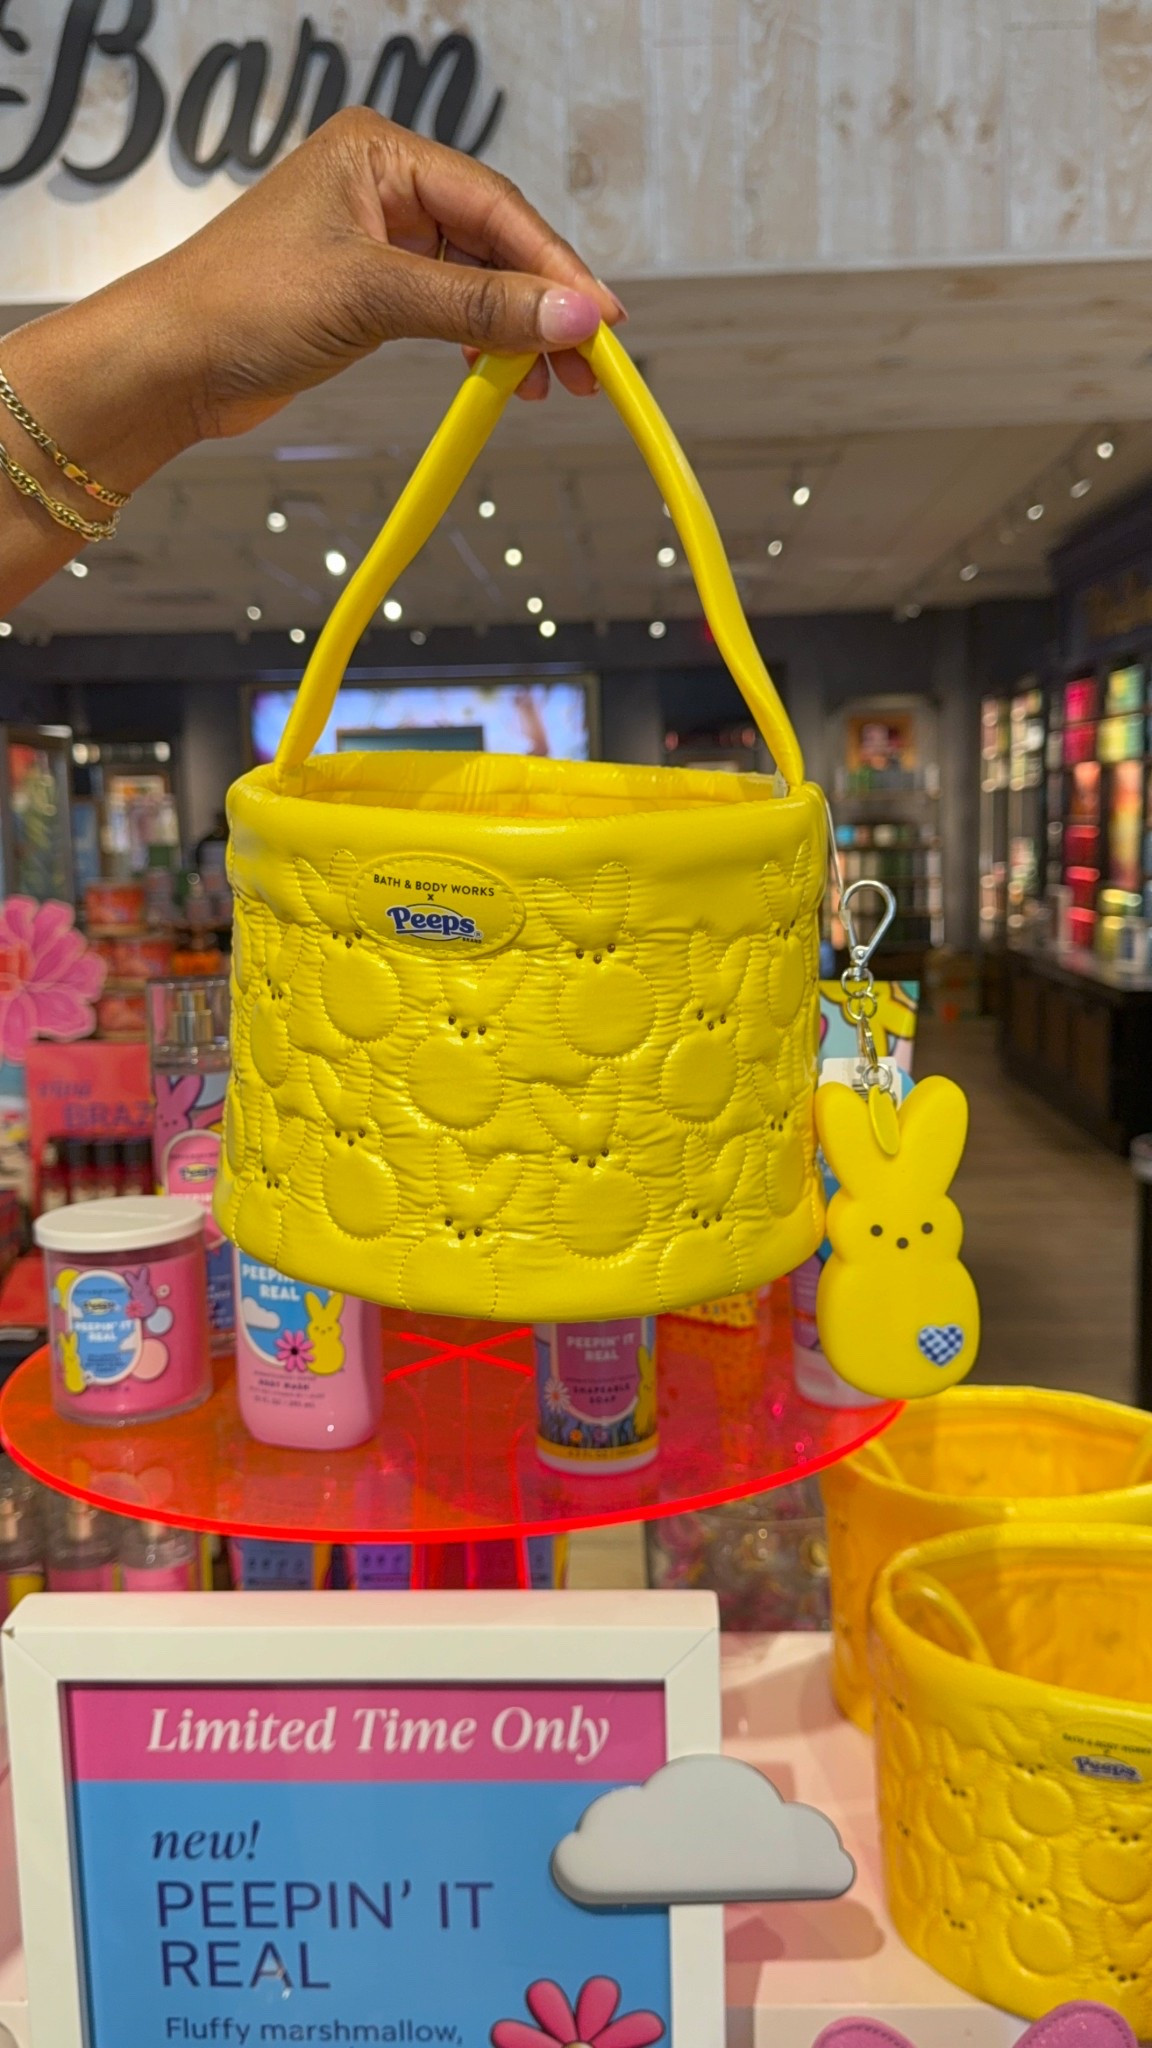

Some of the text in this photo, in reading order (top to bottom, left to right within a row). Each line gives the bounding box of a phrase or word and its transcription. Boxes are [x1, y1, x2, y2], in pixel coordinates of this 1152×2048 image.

[0, 0, 506, 185] Barn
[373, 874, 495, 897] BATH & BODY WORKS
[386, 906, 476, 936] Peeps
[259, 1284, 301, 1301] REAL
[584, 1349, 619, 1361] REAL
[146, 1705, 610, 1765] Limited Time Only
[152, 1820, 261, 1861] new!
[156, 1879, 495, 1930] PEEPIN’ IT
[160, 1940, 331, 1990] REAL
[166, 2017, 464, 2046] Fluffy marshmallow,
